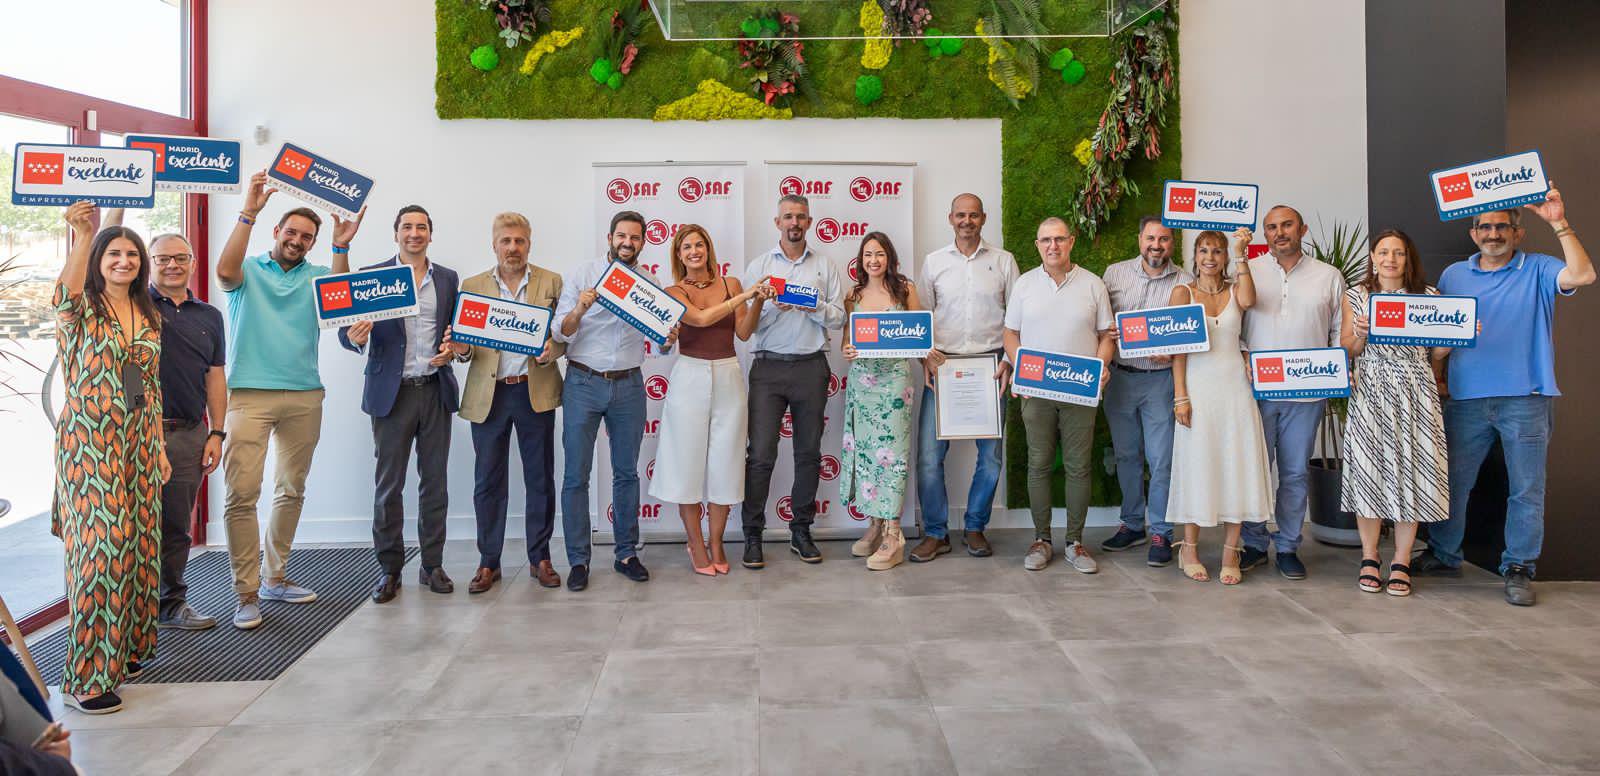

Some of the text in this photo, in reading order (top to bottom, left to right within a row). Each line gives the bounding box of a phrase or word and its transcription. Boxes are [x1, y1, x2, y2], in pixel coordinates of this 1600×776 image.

[68, 155, 105, 164] MADRID
[168, 152, 234, 169] excelente
[67, 162, 144, 180] excelente
[313, 162, 340, 177] MADRID
[1471, 167, 1500, 178] MADRID
[308, 170, 362, 198] excelente
[1474, 166, 1536, 190] excelente
[176, 184, 234, 192] CERTIFICADA
[633, 182, 662, 196] SAF
[704, 181, 732, 195] SAF
[806, 181, 832, 194] SAF
[876, 182, 902, 195] SAF
[1198, 196, 1250, 210] excelente
[1447, 194, 1544, 218] EMPRESA CERTIFICADA
[842, 222, 868, 236] SAF
[352, 279, 379, 287] MADRID
[354, 278, 409, 301] excelente
[636, 284, 656, 299] MADRID
[492, 307, 517, 316] MADRID
[630, 291, 673, 322] excelente
[489, 315, 542, 333] excelente
[1408, 309, 1469, 324] excelente
[880, 322, 928, 338] excelente
[1150, 316, 1200, 336] excelente
[1414, 338, 1468, 346] CERTIFICADA
[1047, 360, 1070, 368] MADRID
[1286, 360, 1341, 378] excelente
[1046, 366, 1096, 384] excelente
